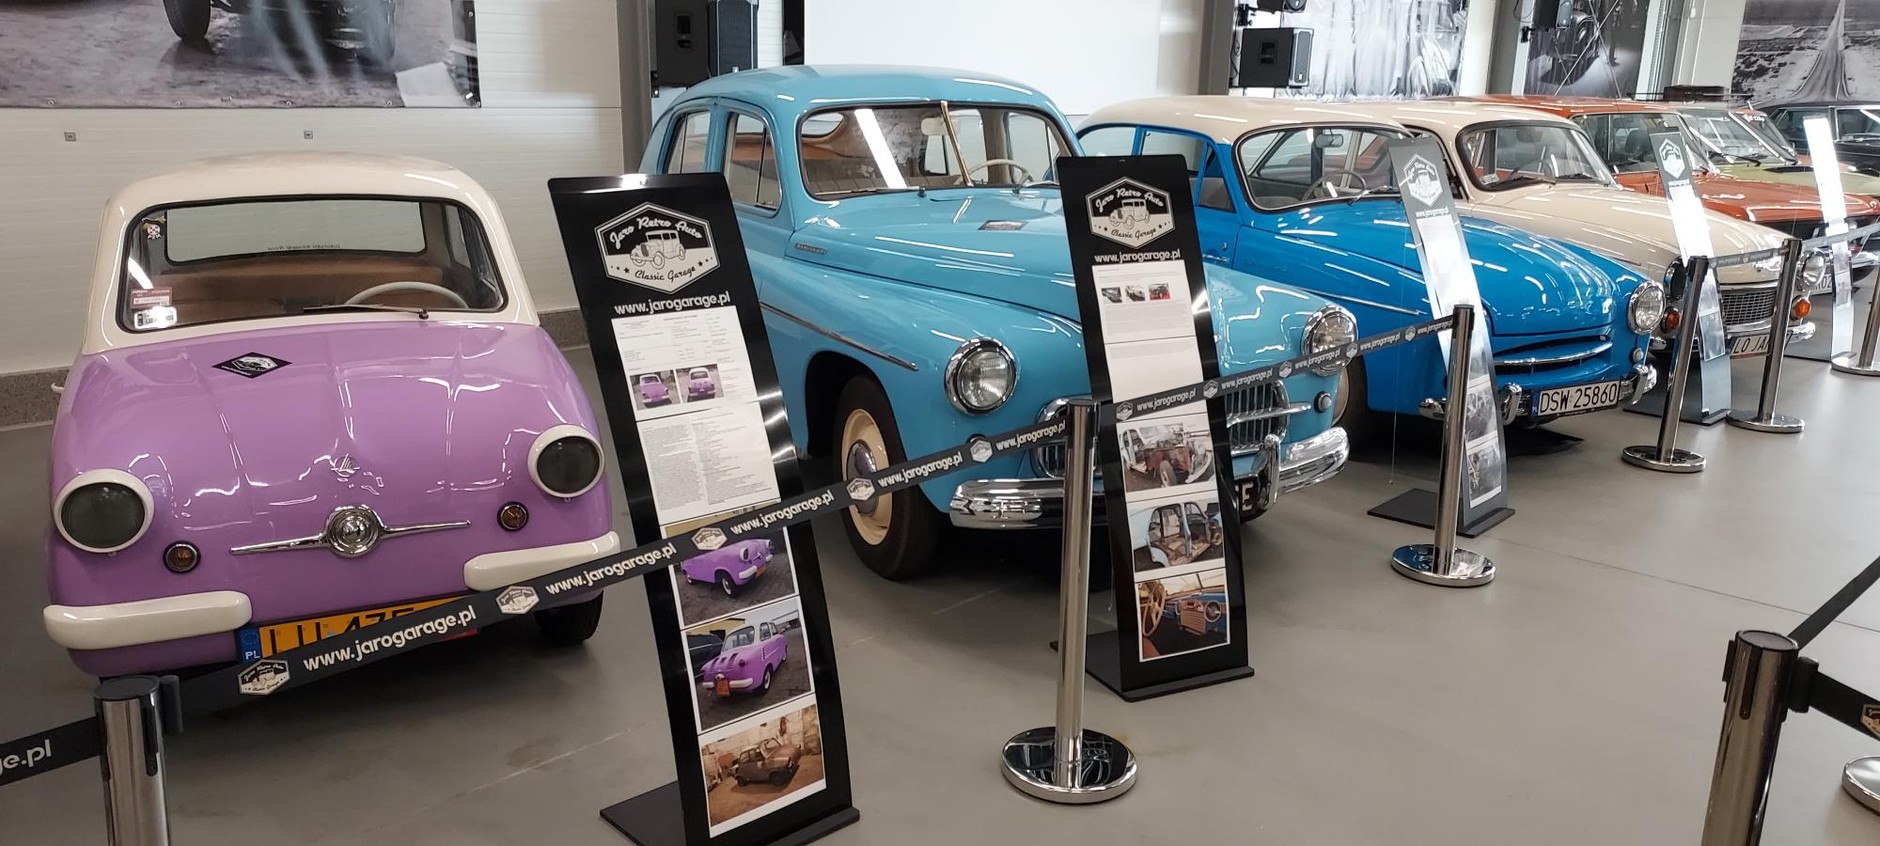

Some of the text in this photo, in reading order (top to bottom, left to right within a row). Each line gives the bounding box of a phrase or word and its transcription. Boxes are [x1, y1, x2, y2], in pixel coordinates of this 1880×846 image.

[1116, 187, 1142, 198] Retro
[1144, 192, 1164, 207] Auto
[609, 216, 703, 250] Jaro Retro Auto
[1094, 248, 1181, 264] www.jarogarage.pl
[634, 266, 696, 283] Classic Garage
[613, 290, 731, 315] www.jarogarage.pl
[1136, 388, 1197, 415] www.jarogarage.pl
[1540, 383, 1618, 413] DSW 25860
[995, 419, 1067, 452] www.jarogarage.pl
[877, 451, 963, 489] www.jarogarage.pl
[730, 490, 835, 536] www.jarogarage.pl
[546, 543, 677, 596] www.jarogarage.pl
[303, 604, 476, 672] www.jarogarage.pl
[244, 650, 261, 660] PL
[0, 738, 52, 776] e.pl
